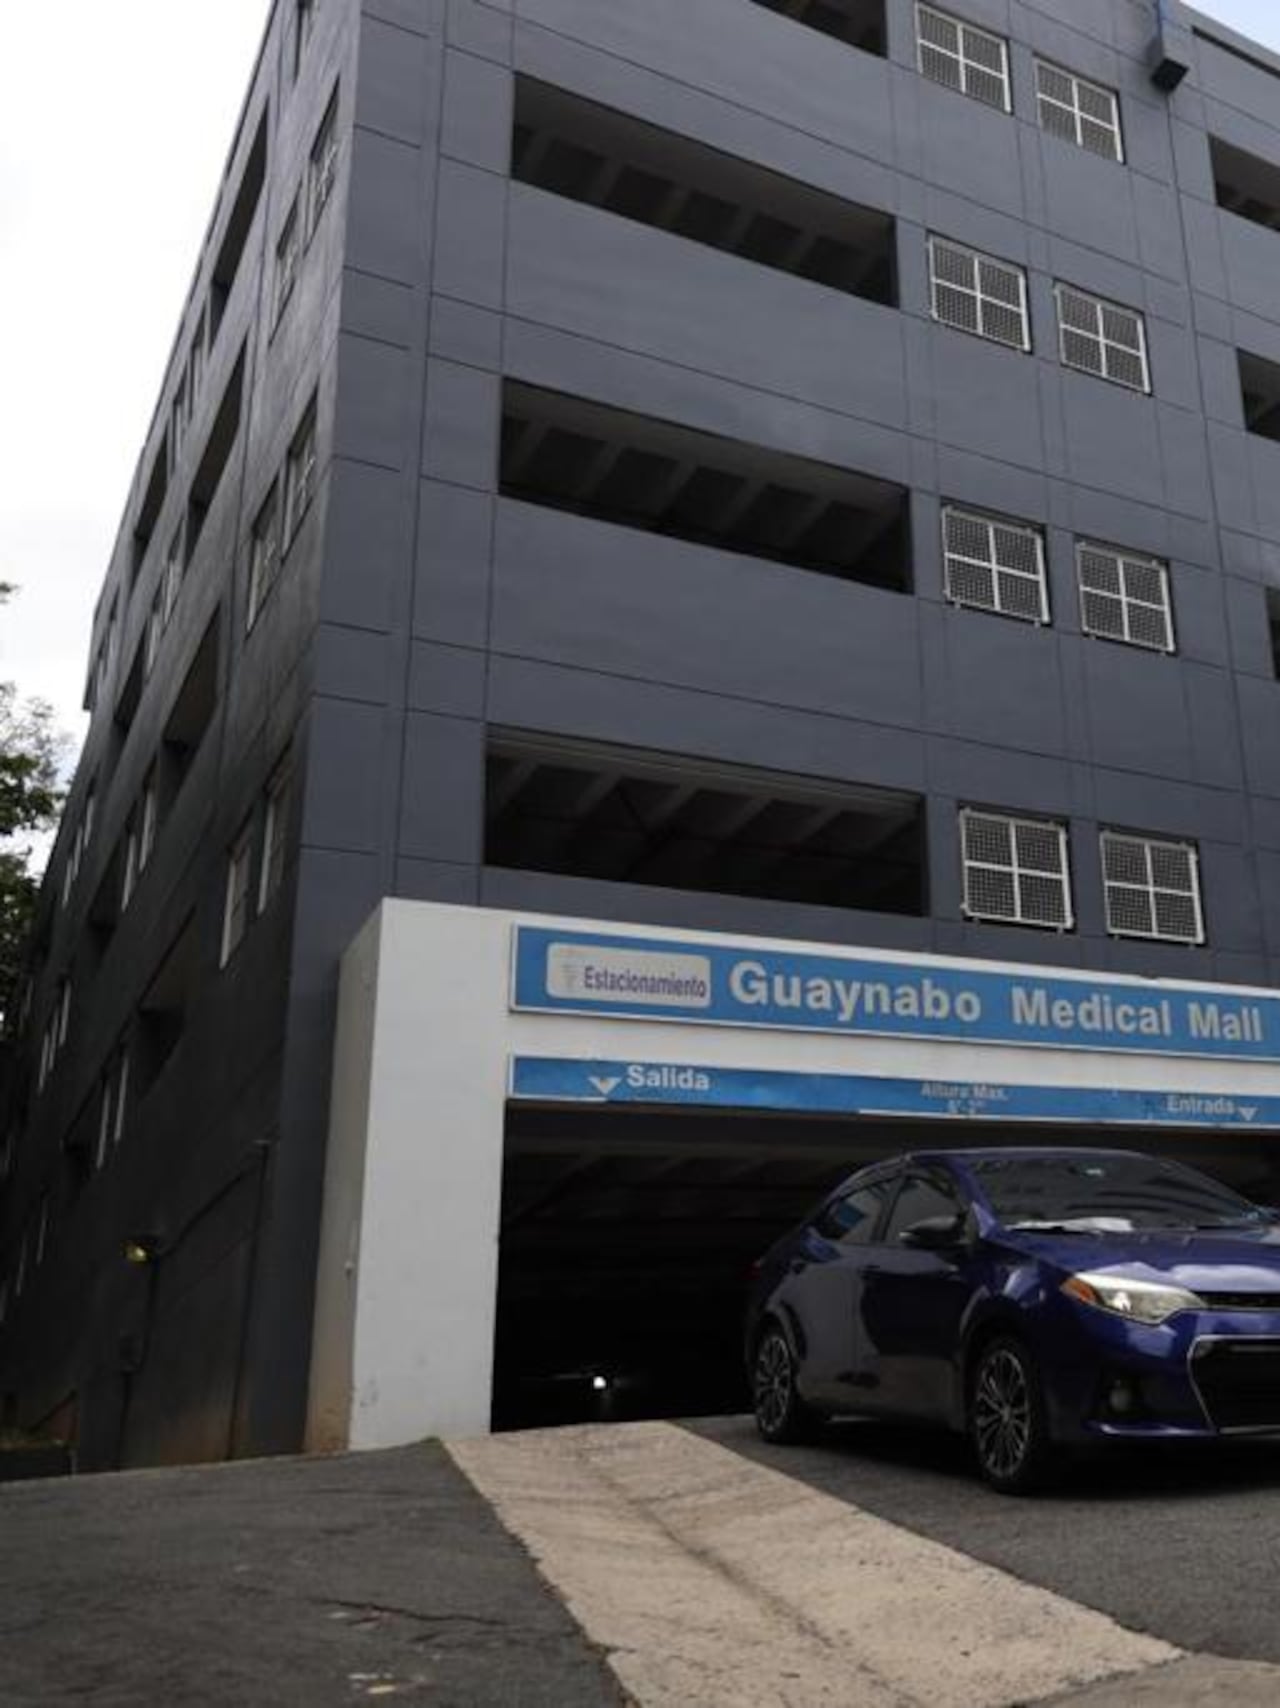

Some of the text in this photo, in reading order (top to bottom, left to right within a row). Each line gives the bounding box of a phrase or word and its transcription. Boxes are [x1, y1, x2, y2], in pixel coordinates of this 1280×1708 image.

[584, 965, 708, 998] Estacionamiento
[729, 960, 1264, 1042] Guaynabo Medical Mall
[626, 1064, 710, 1092] Salida
[1166, 1093, 1236, 1115] Entrada
